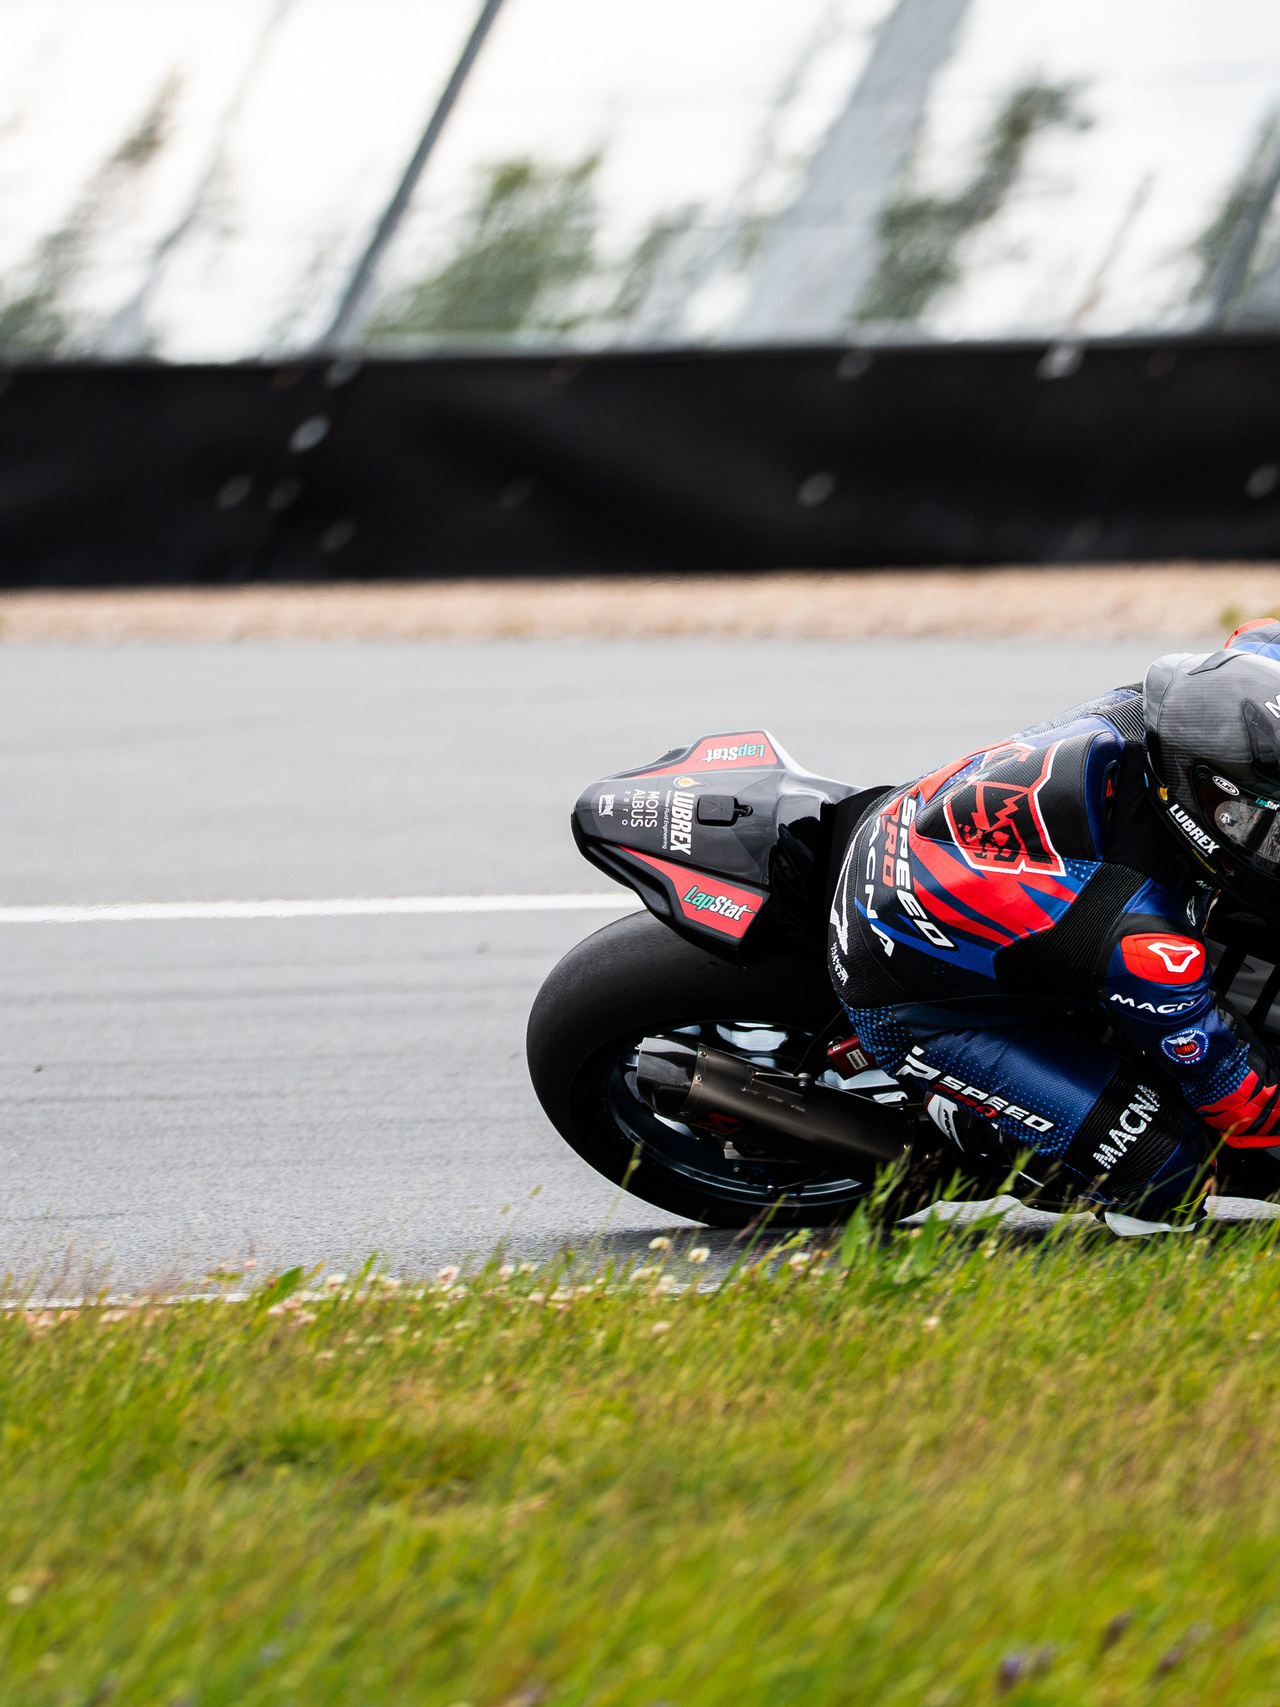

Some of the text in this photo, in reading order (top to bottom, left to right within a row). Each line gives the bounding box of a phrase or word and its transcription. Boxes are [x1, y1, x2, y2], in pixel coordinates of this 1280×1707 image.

[698, 744, 766, 763] LapStat
[630, 789, 646, 827] ALBUS
[645, 791, 660, 828] MONS
[670, 791, 695, 855] LUBREX
[1168, 803, 1221, 855] LUBREX
[896, 796, 954, 948] SPEED
[683, 885, 757, 922] LapStat
[1110, 993, 1196, 1014] MACN
[931, 1083, 1000, 1119] PRO
[939, 1075, 1055, 1133] SPEED
